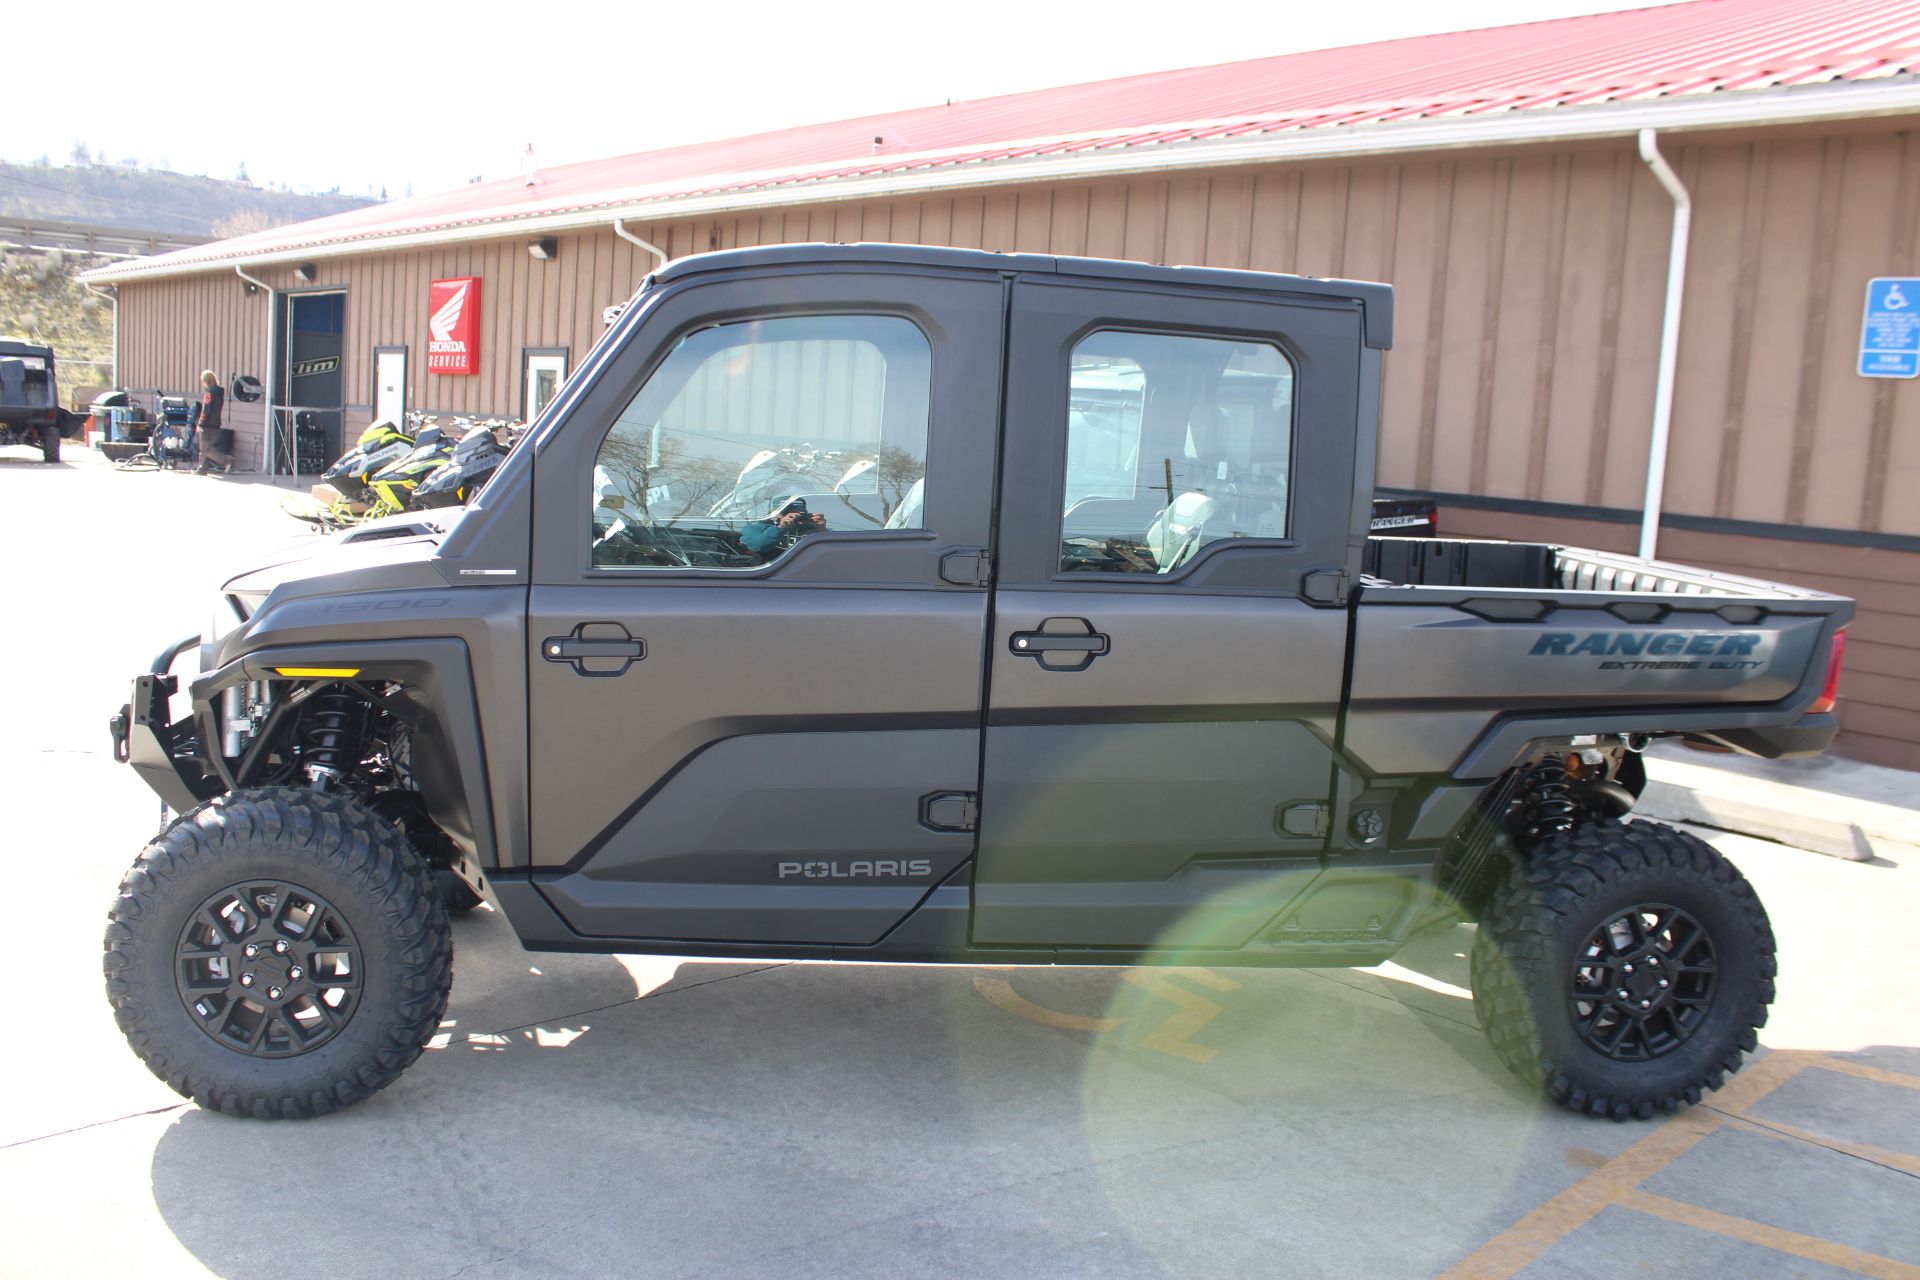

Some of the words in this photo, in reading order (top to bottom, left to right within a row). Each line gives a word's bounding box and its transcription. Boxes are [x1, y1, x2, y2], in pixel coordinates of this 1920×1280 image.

[430, 341, 466, 352] HONDA
[429, 355, 466, 367] SERVICE
[1371, 515, 1416, 528] RANGER
[1528, 633, 1762, 656] RANGER
[1598, 661, 1702, 670] EXTREME
[1707, 661, 1765, 670] DUTY
[778, 860, 932, 878] POLARIS
